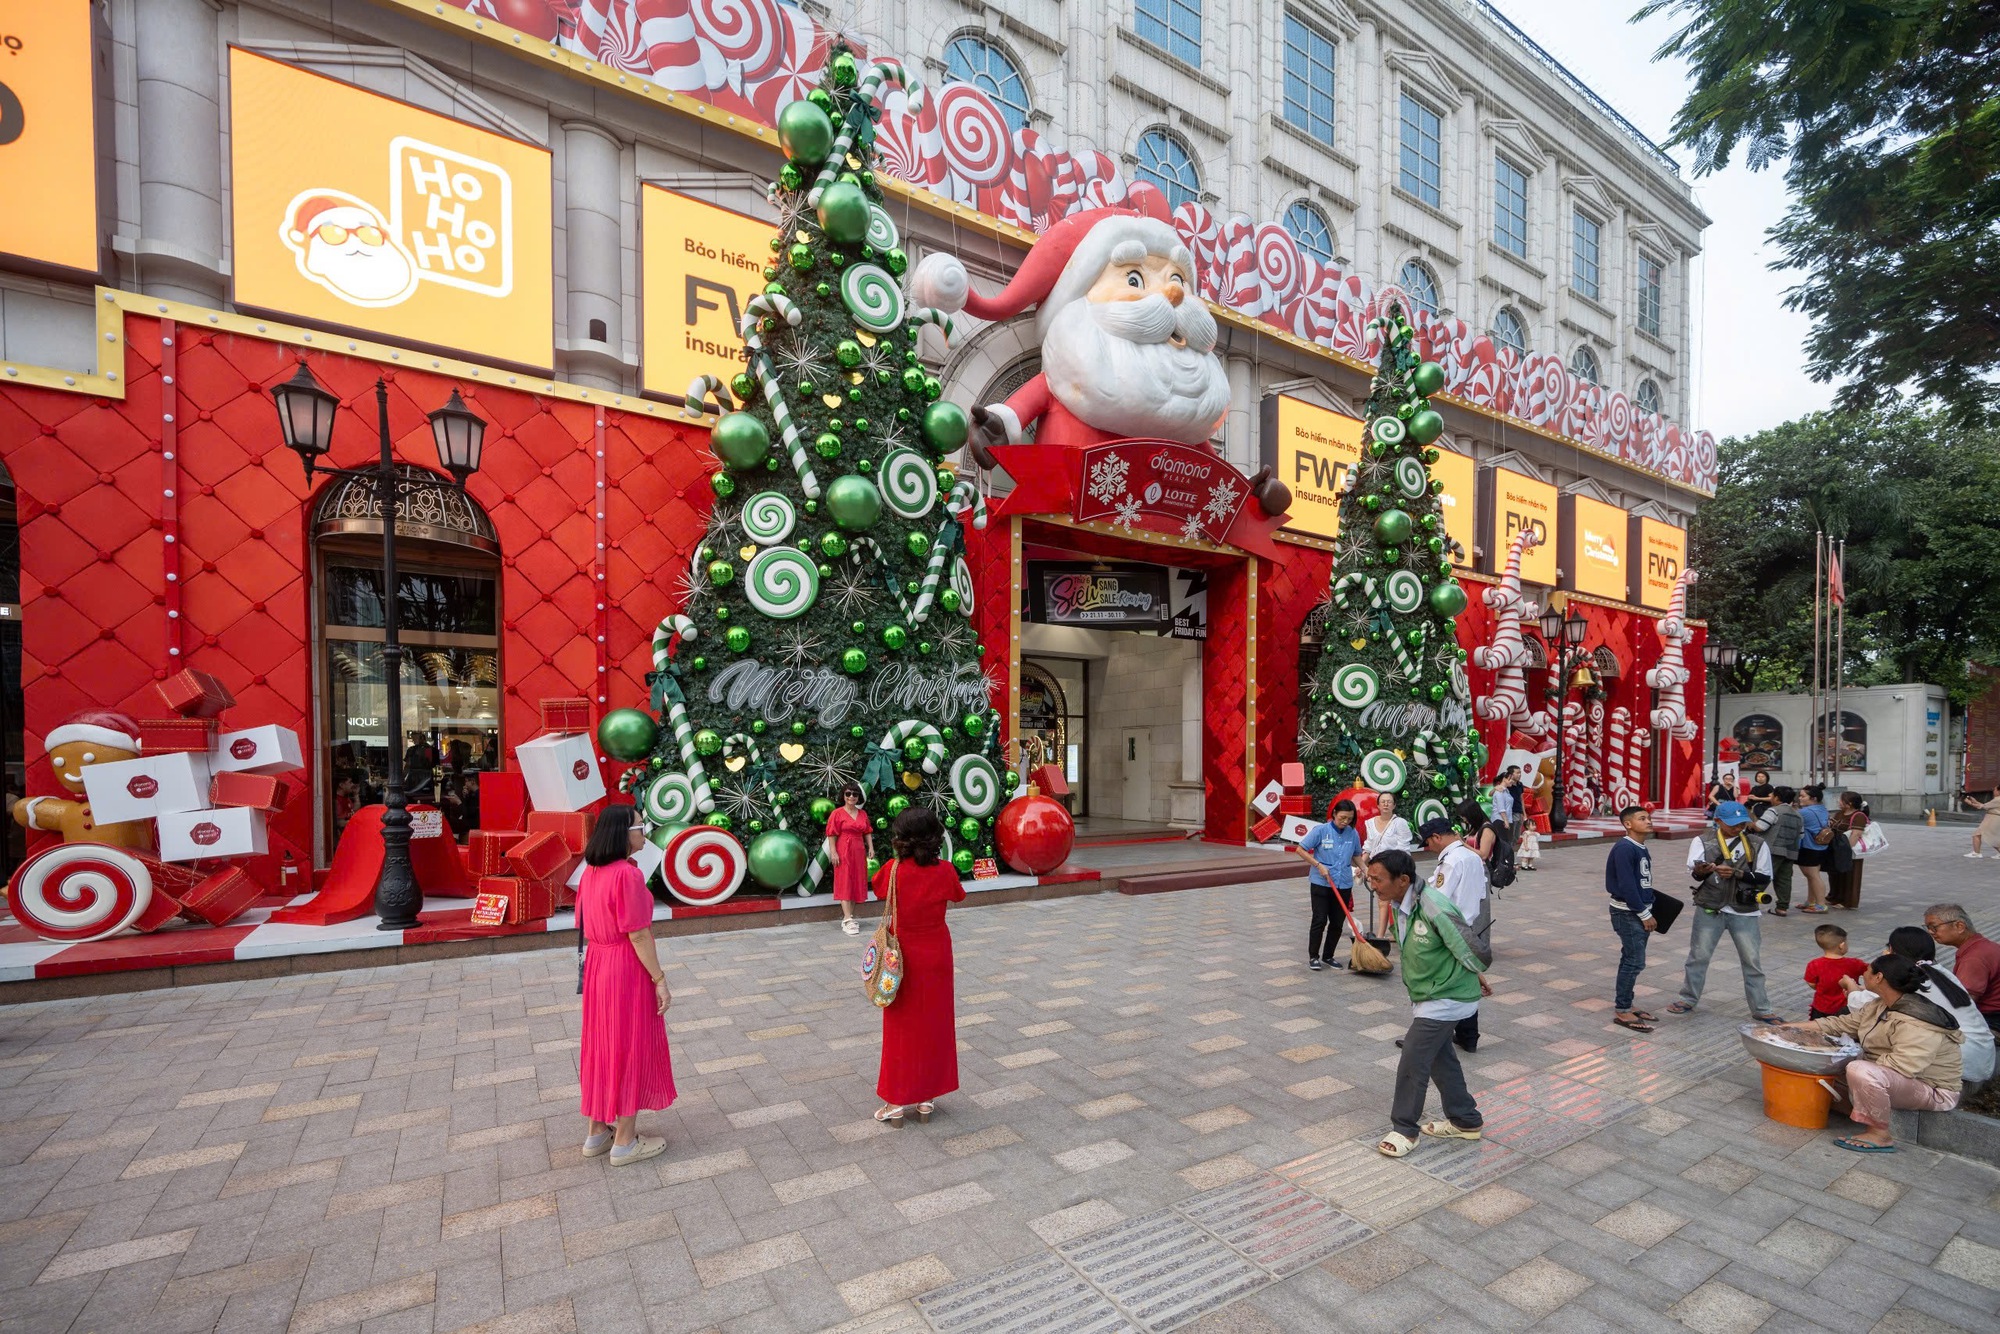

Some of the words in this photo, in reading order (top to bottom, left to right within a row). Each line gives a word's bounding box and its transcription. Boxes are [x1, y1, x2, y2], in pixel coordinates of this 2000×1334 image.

[685, 237, 716, 259] Bảo
[721, 248, 760, 273] hiểm
[1295, 427, 1309, 439] Bảo
[1310, 431, 1327, 446] hiểm
[1328, 438, 1346, 450] nhân
[1346, 443, 1357, 456] thọ
[1151, 450, 1211, 479] diamond
[1163, 473, 1190, 484] PLAZA
[1164, 489, 1198, 503] LOTTE
[1295, 486, 1338, 507] insurance
[1649, 552, 1678, 581] FWD
[1099, 579, 1117, 591] SANG
[1100, 593, 1116, 604] SALE
[1174, 617, 1189, 628] BEST
[1174, 627, 1194, 637] FRIDAY
[708, 658, 868, 729] Merry
[869, 660, 992, 723] Christmas
[1360, 699, 1442, 738] Merry
